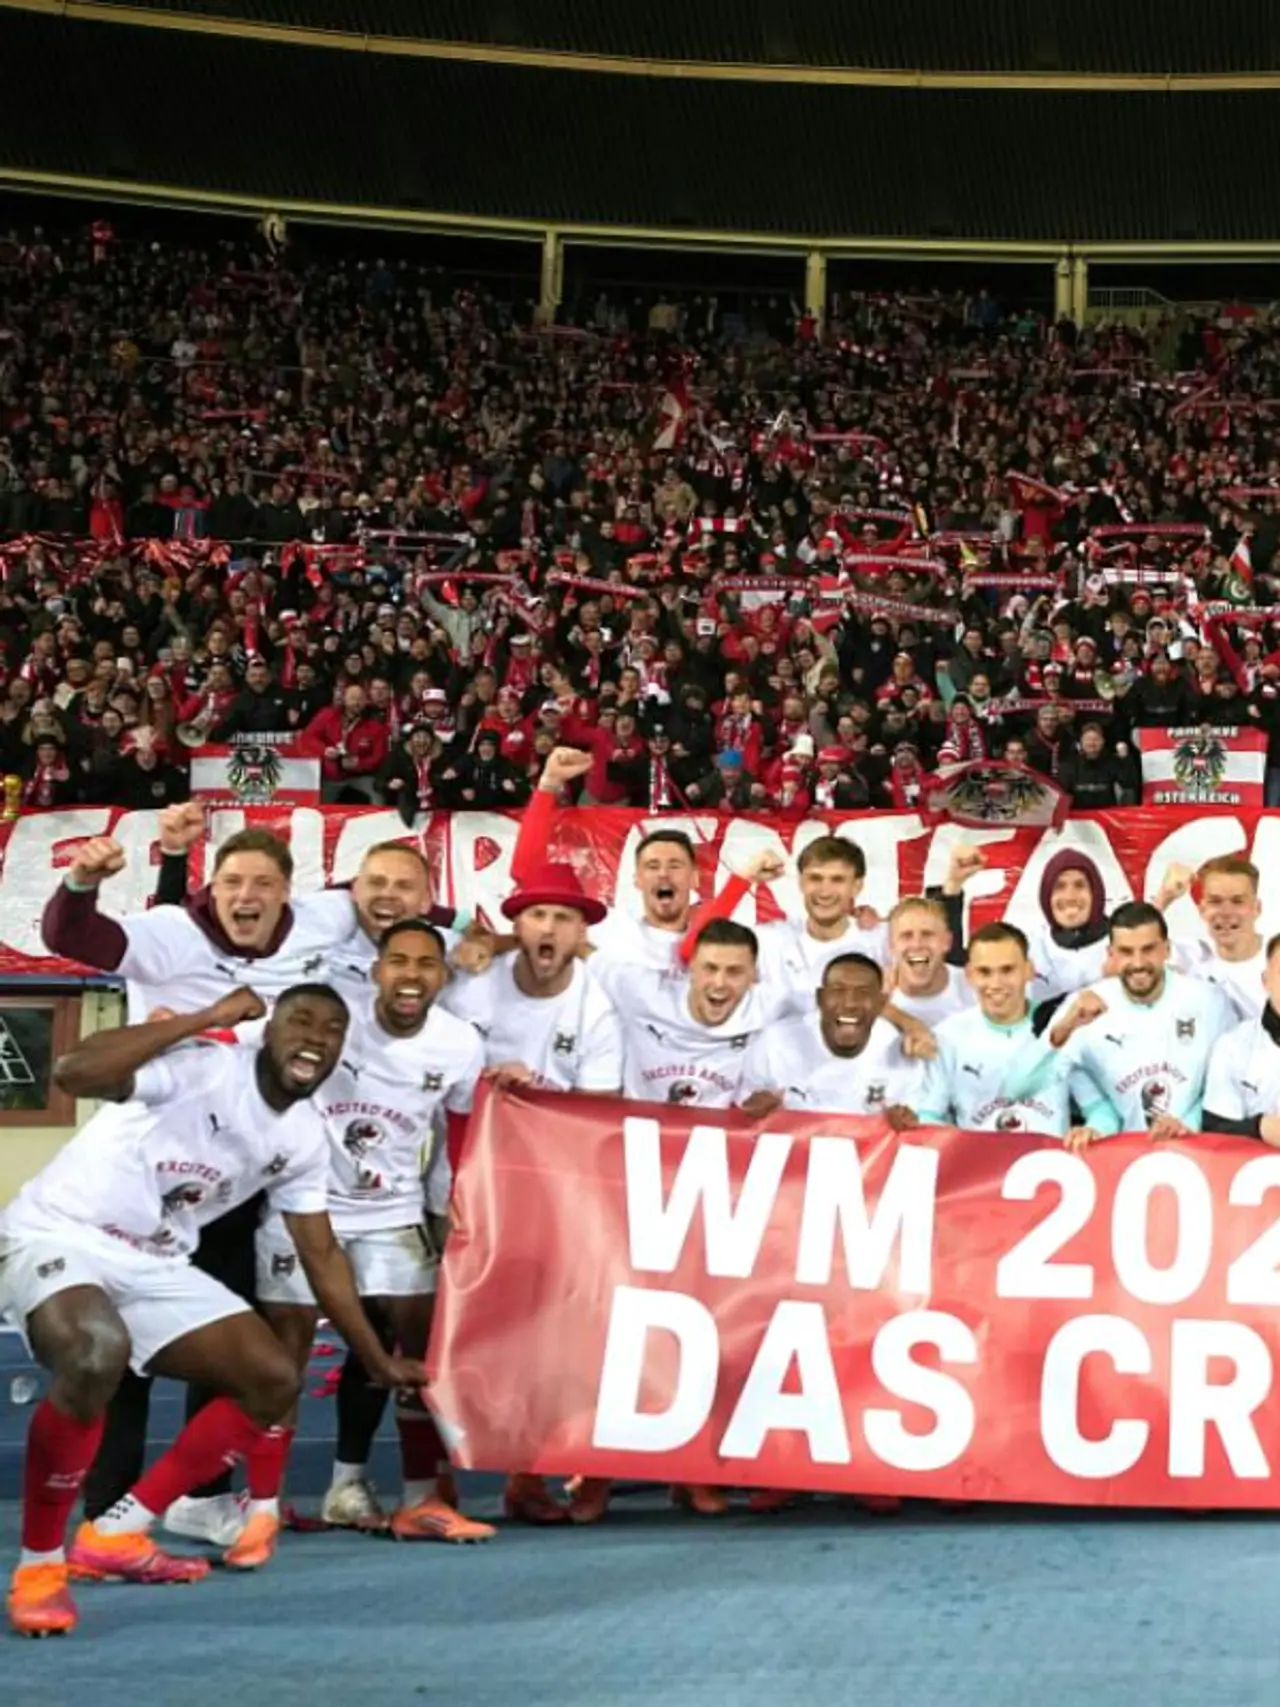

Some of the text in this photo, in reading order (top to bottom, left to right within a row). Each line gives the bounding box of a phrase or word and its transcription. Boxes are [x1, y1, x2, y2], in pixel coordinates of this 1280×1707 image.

[1167, 725, 1239, 738] FANKRVE
[623, 1116, 939, 1296] WM
[592, 1285, 978, 1471] DAS
